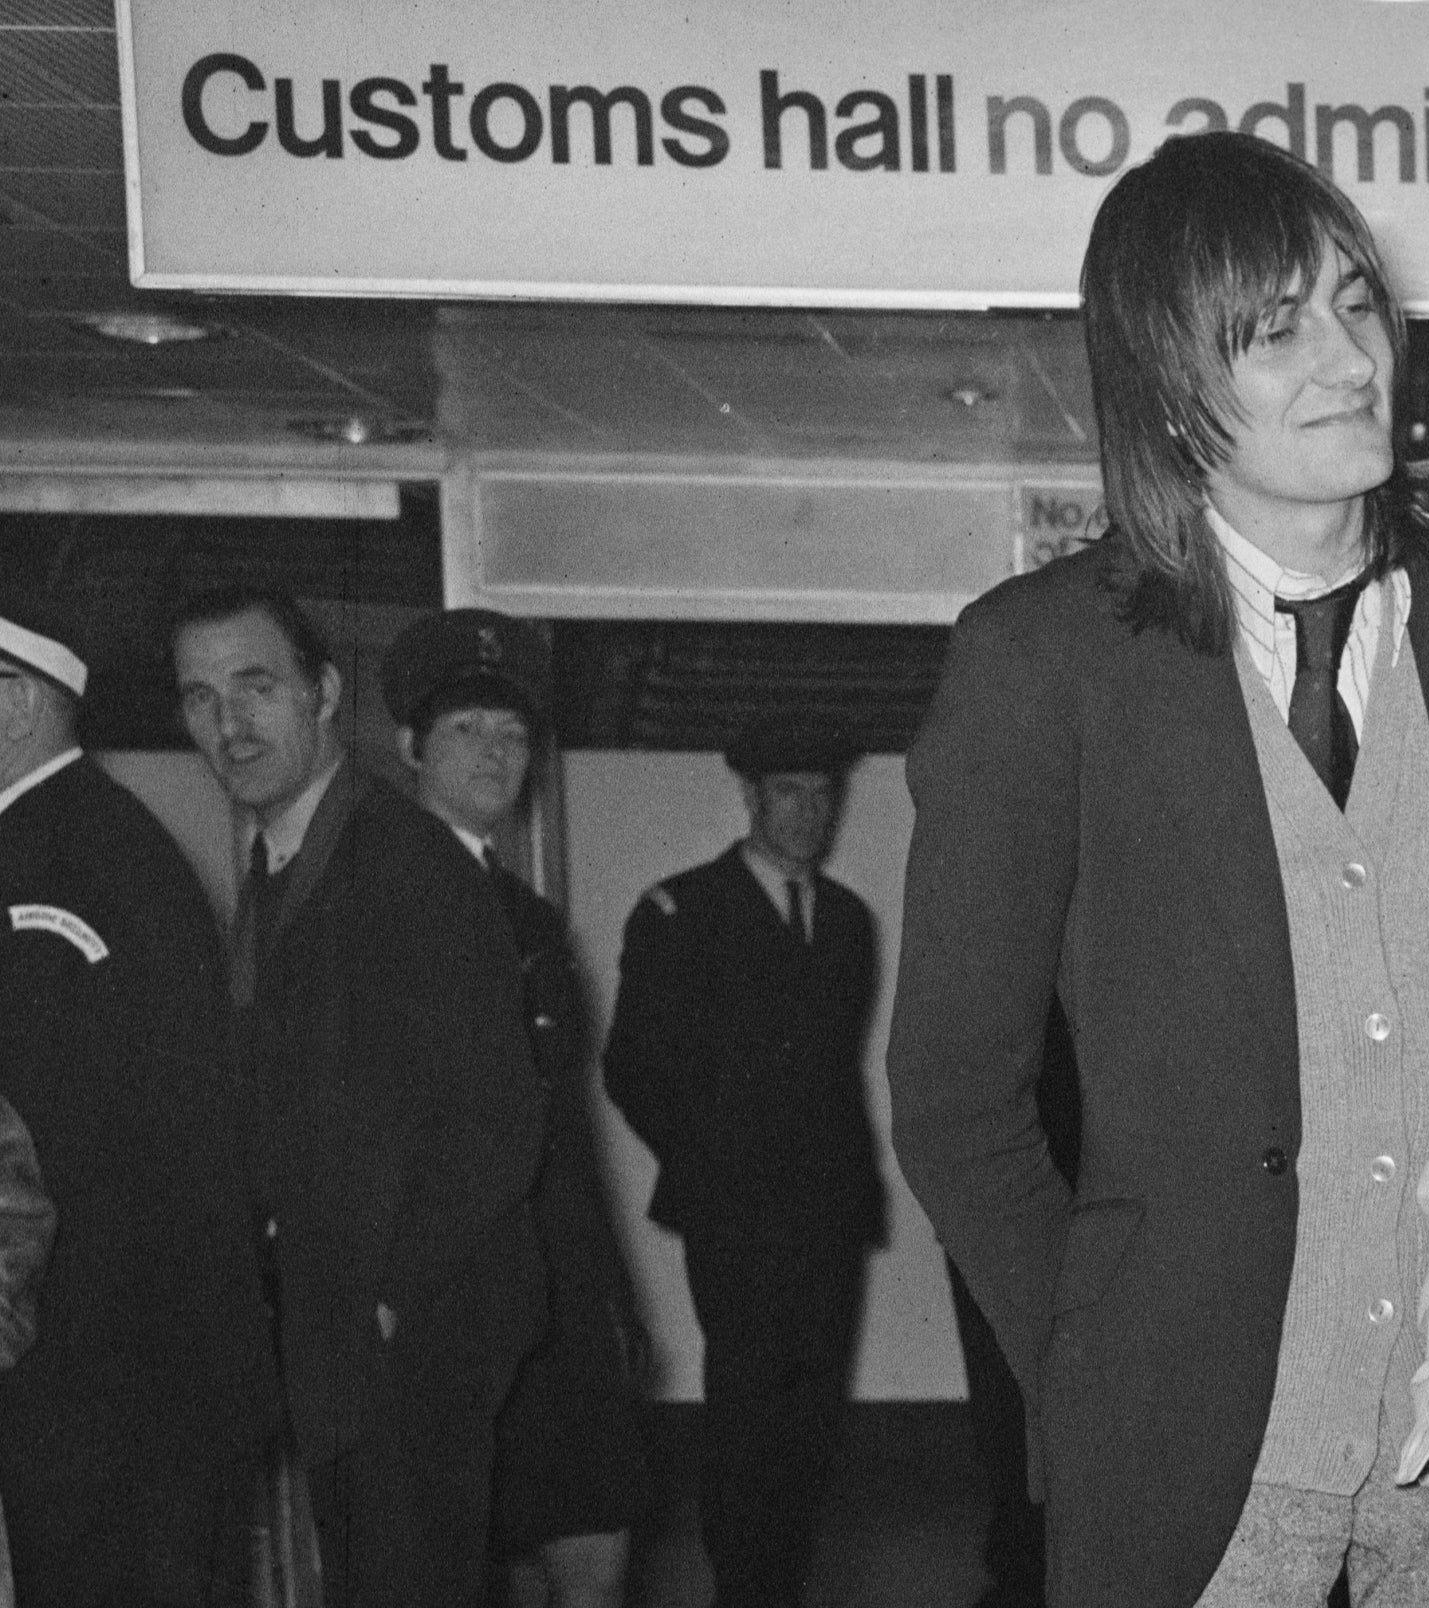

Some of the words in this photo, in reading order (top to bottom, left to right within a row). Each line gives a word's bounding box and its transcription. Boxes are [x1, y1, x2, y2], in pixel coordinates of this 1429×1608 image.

[182, 52, 730, 168] Customs
[760, 69, 956, 174] hall
[986, 94, 1132, 178] no
[1031, 495, 1083, 529] No
